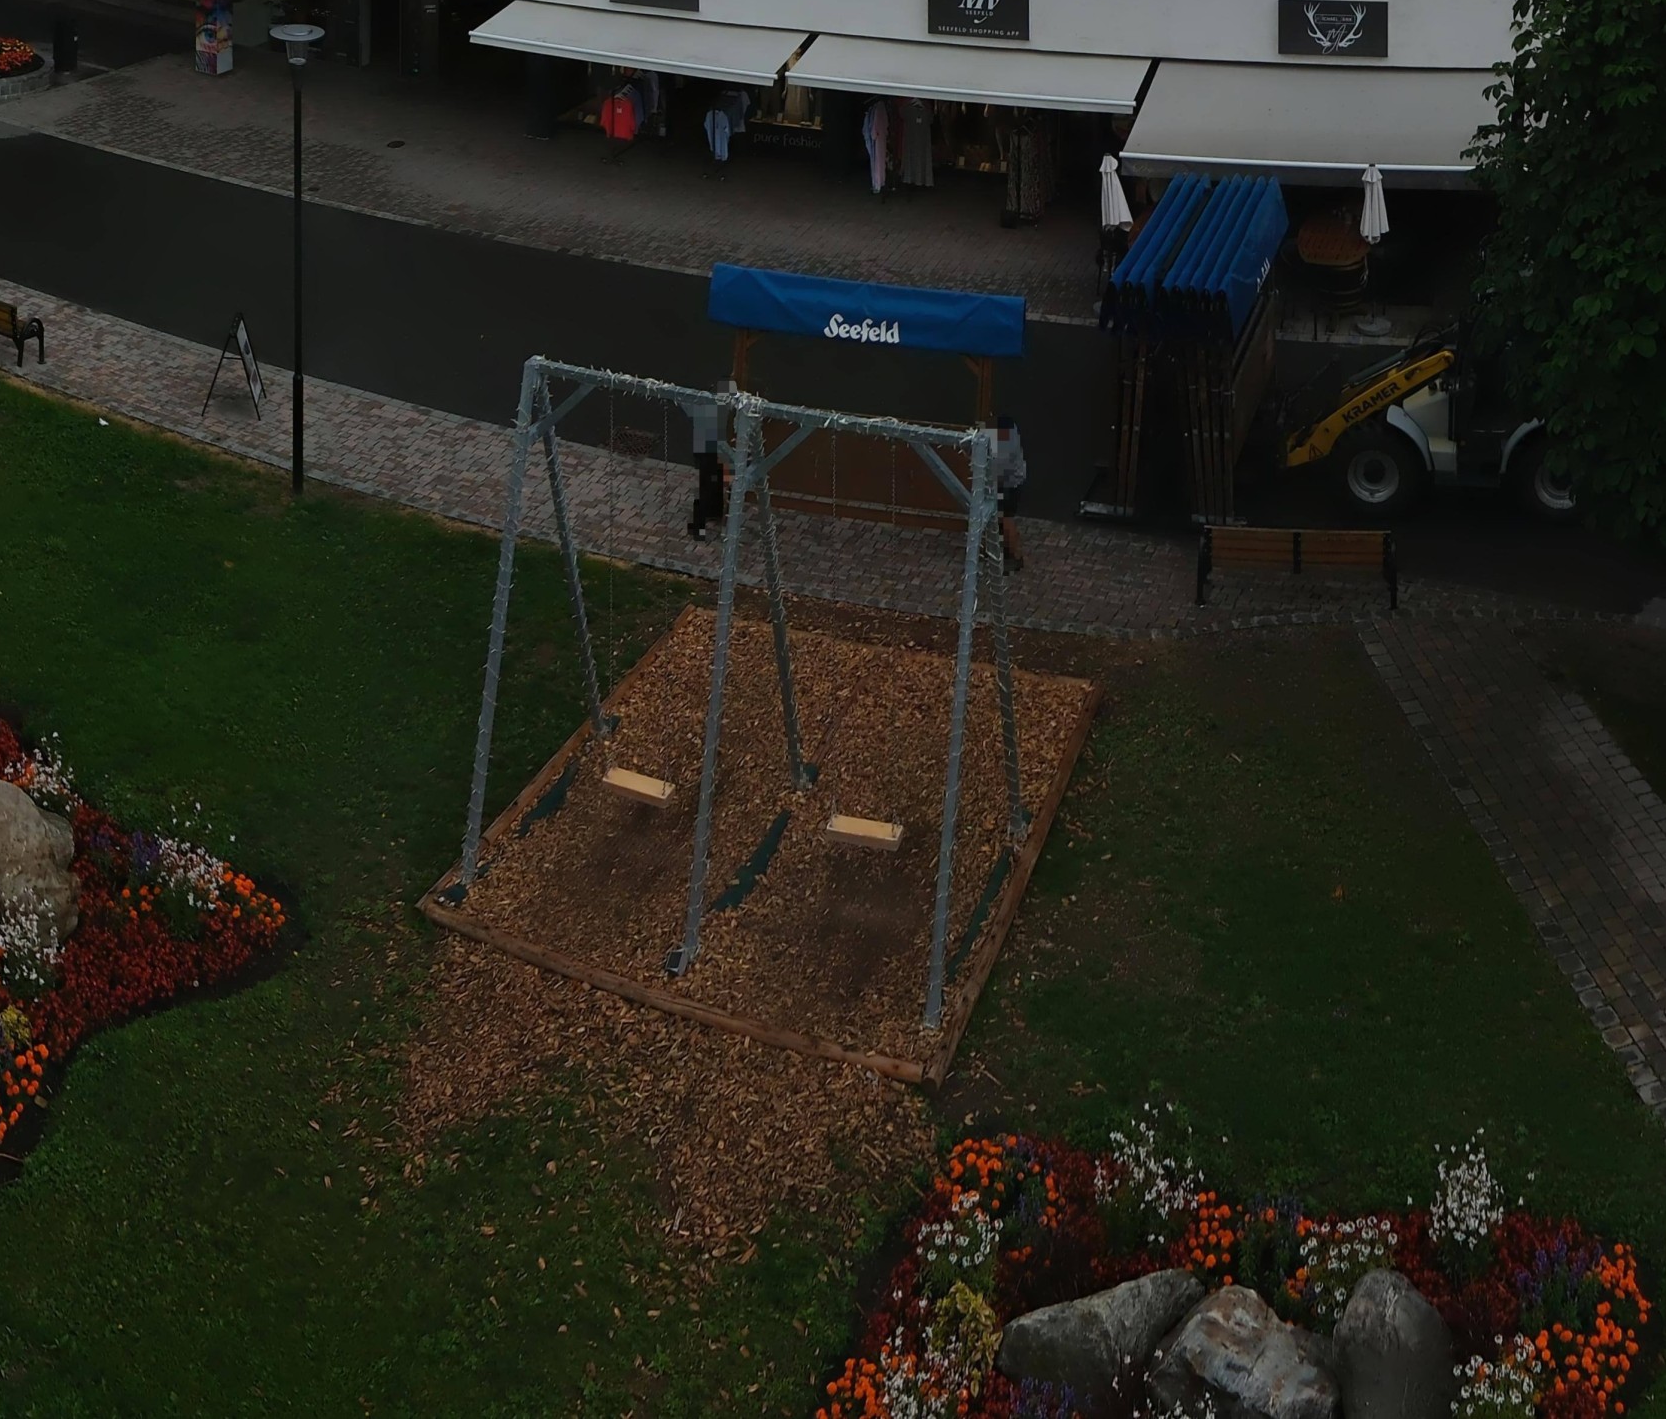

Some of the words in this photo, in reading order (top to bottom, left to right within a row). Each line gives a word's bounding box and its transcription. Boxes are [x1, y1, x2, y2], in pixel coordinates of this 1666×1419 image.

[938, 25, 967, 33] SEEFELD
[969, 28, 1004, 36] SHOPPING
[824, 314, 900, 344] Seefeld
[1342, 382, 1401, 423] KRAMER
